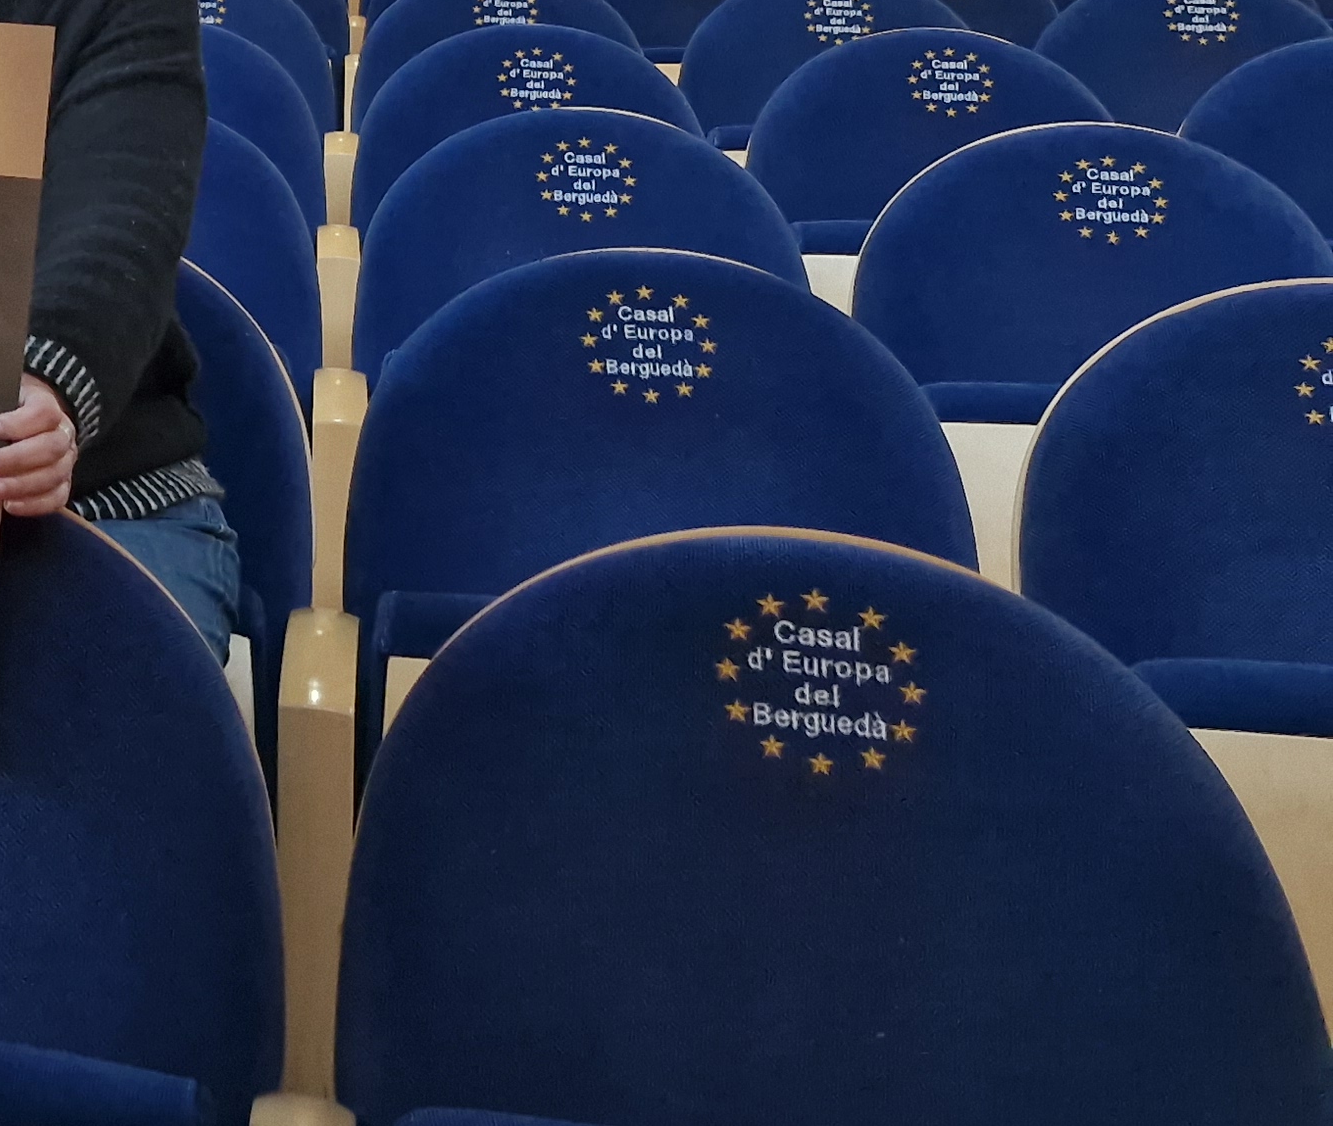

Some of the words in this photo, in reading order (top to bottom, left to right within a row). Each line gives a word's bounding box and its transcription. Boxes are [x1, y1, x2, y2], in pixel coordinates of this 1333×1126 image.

[520, 58, 554, 69] Casal
[932, 60, 968, 70] Casal
[526, 80, 545, 89] del
[939, 81, 959, 91] del
[510, 88, 562, 101] Berguedà
[923, 90, 978, 104] Berguedà
[564, 152, 606, 164] Casal
[568, 165, 620, 180] Europa
[1086, 168, 1134, 181] Casal
[573, 179, 596, 191] del
[1090, 182, 1151, 198] Europa
[553, 190, 618, 205] Berguedà
[1097, 197, 1123, 210] del
[1075, 208, 1149, 224] Berguedà
[617, 306, 675, 322] Casal
[623, 324, 694, 345] Europa
[632, 344, 662, 359] del
[605, 359, 693, 379] Berguedà
[773, 620, 860, 652] Casal
[783, 648, 890, 686] Europa
[795, 682, 840, 708] del
[751, 702, 887, 740] Berguedà
